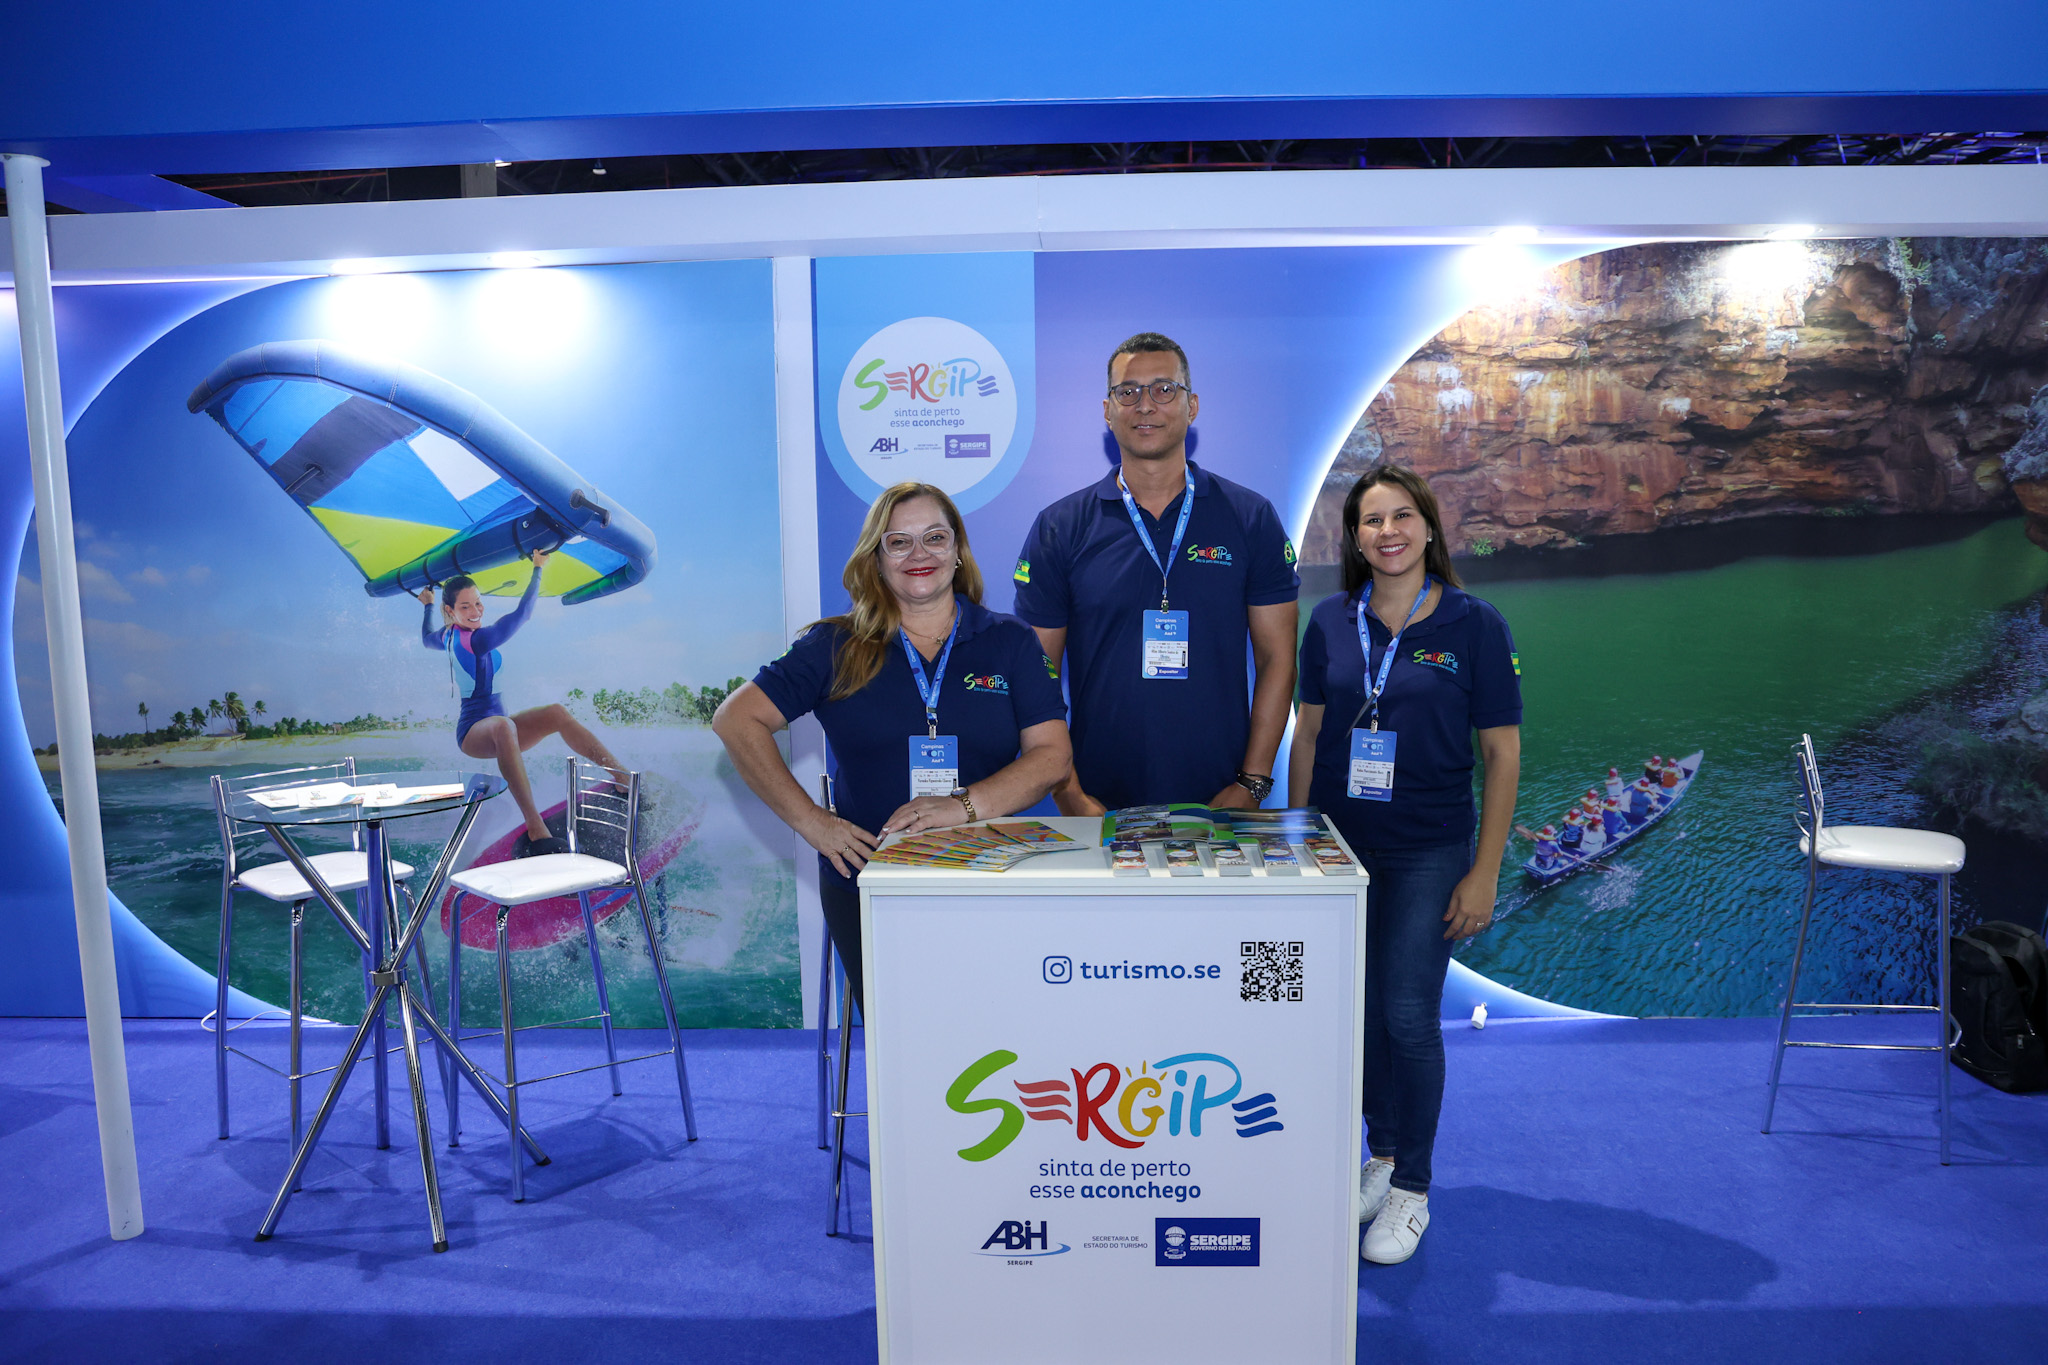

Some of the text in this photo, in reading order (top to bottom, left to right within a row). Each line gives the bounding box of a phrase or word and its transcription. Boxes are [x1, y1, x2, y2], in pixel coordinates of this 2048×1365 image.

[894, 408, 960, 418] sinta de perto
[912, 417, 965, 428] aconchego
[1080, 959, 1221, 980] turismo.se
[1039, 1159, 1191, 1181] sinta de perto
[1029, 1181, 1201, 1203] esse aconchego
[1190, 1235, 1251, 1246] SERGIPE
